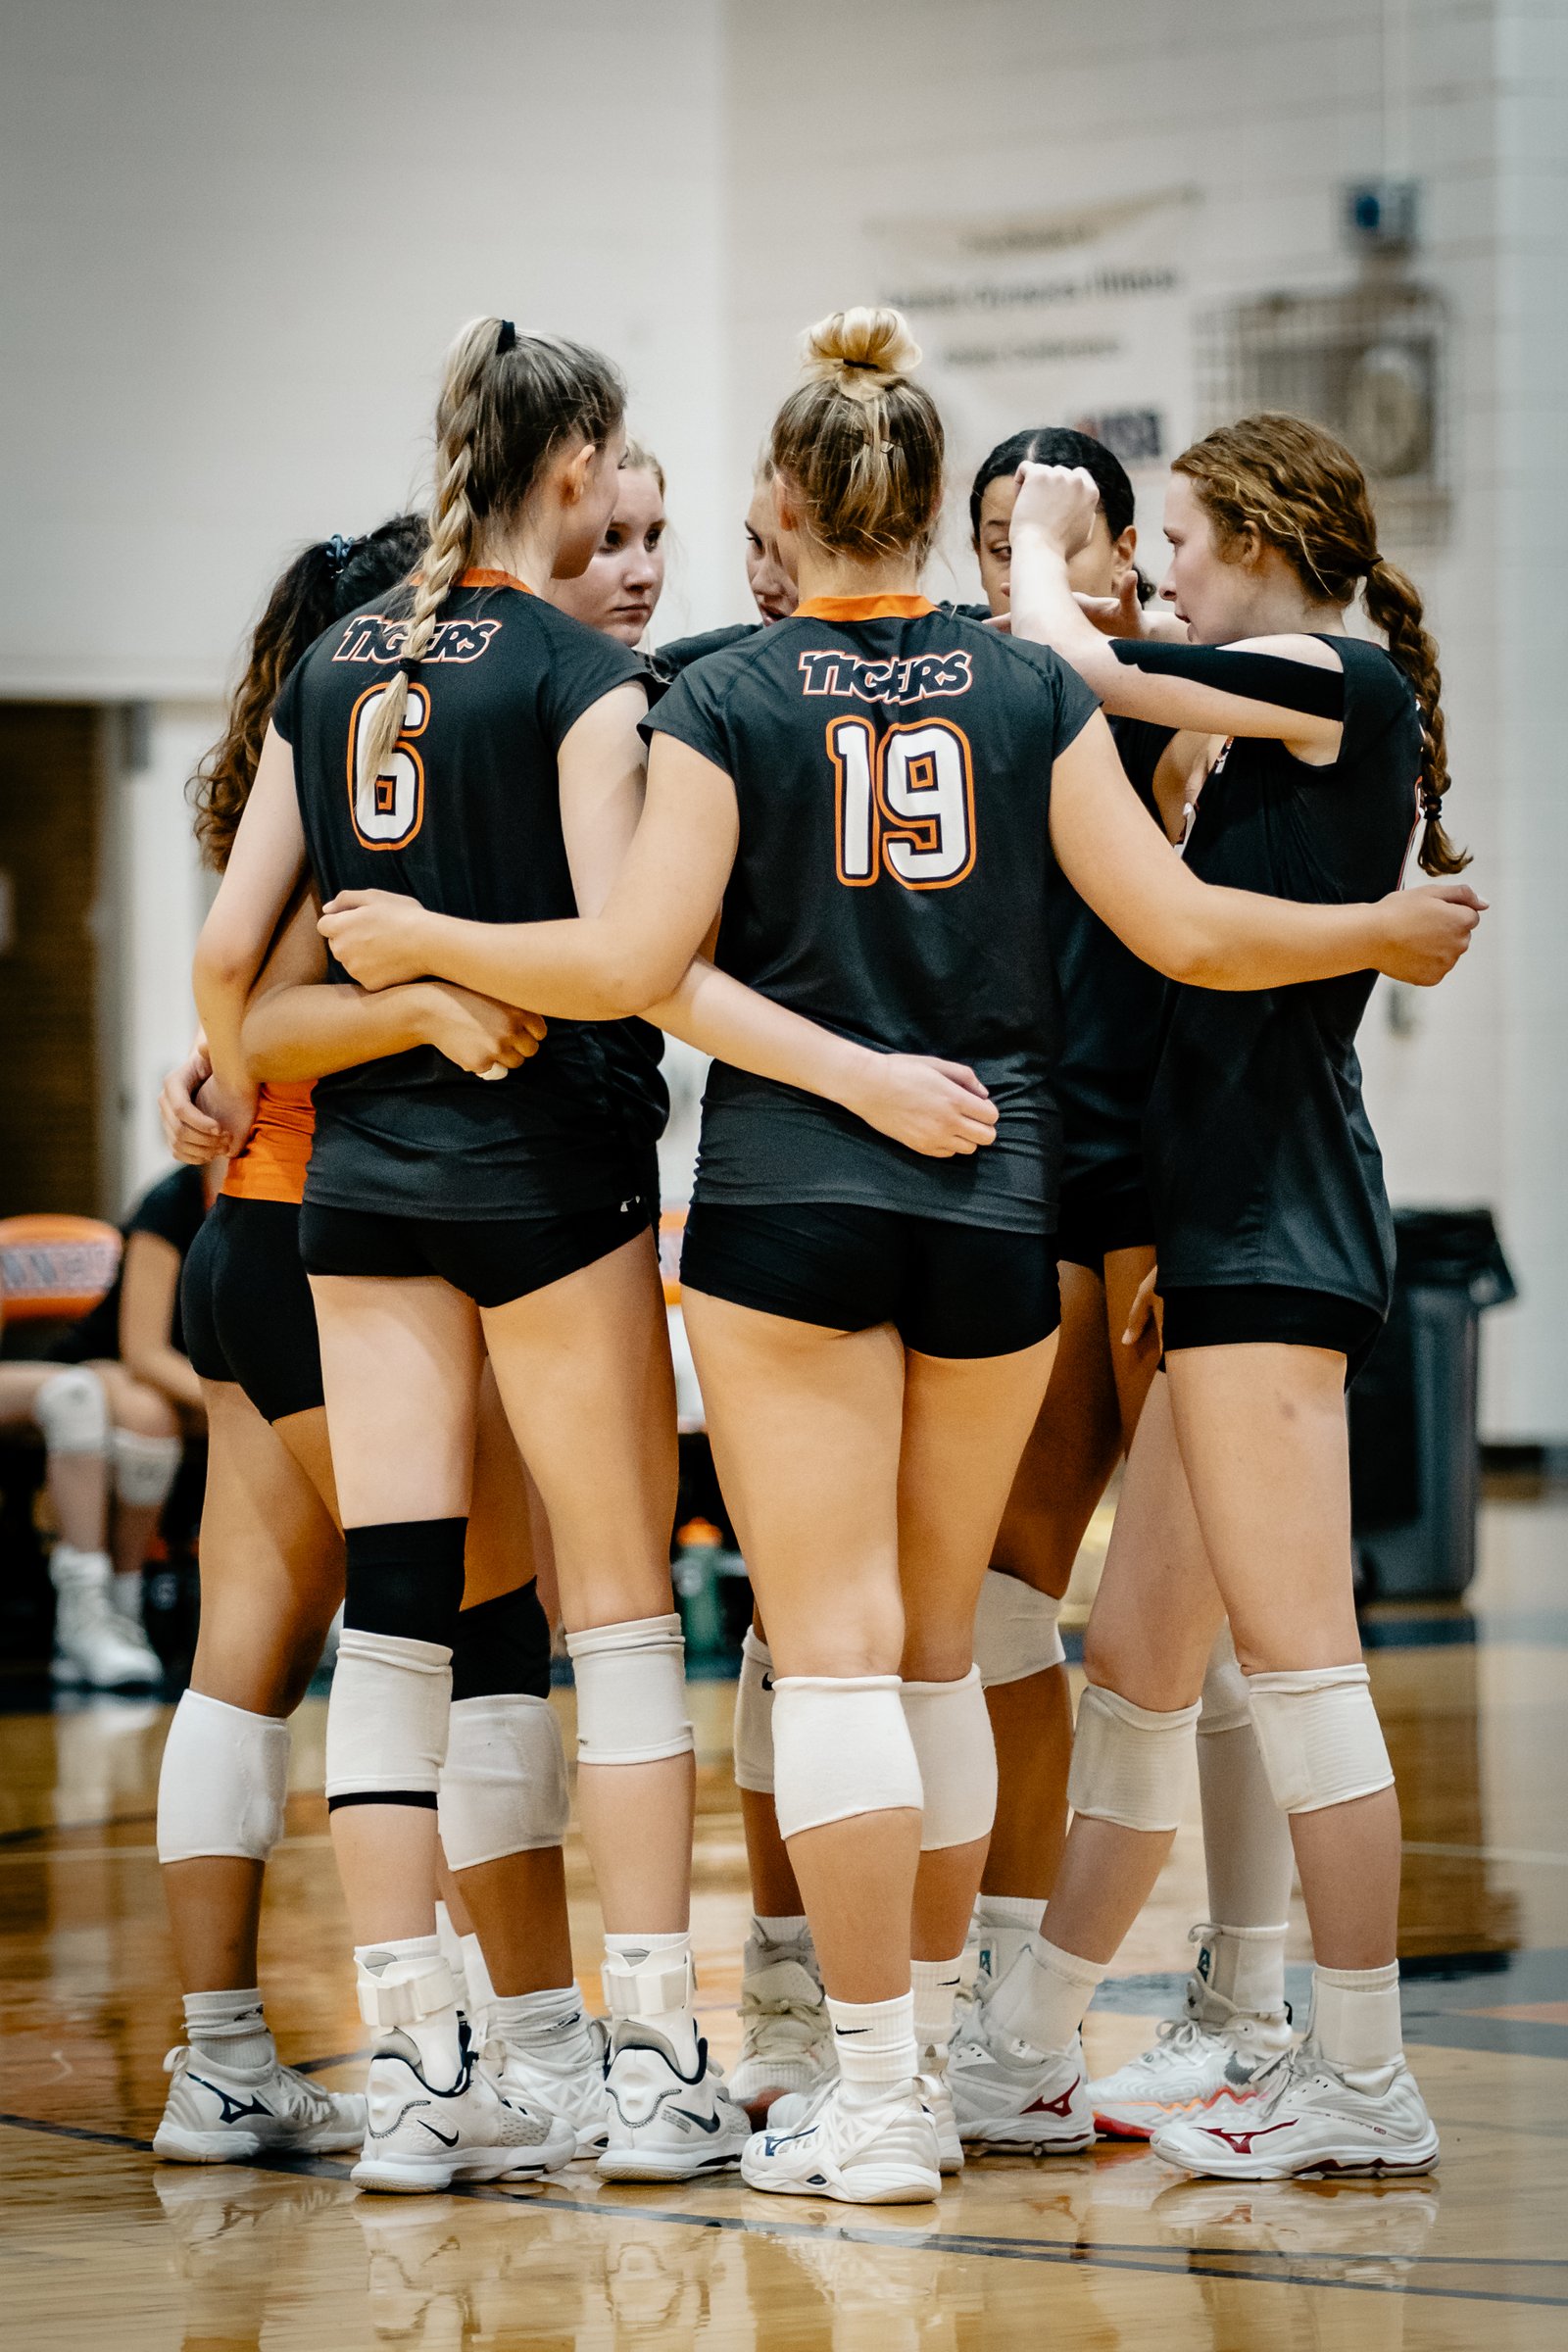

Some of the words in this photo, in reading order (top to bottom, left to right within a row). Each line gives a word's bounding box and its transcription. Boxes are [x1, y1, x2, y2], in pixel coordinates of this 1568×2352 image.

[798, 649, 973, 707] TIGERS
[346, 682, 431, 851] 6
[825, 714, 977, 892] 19
